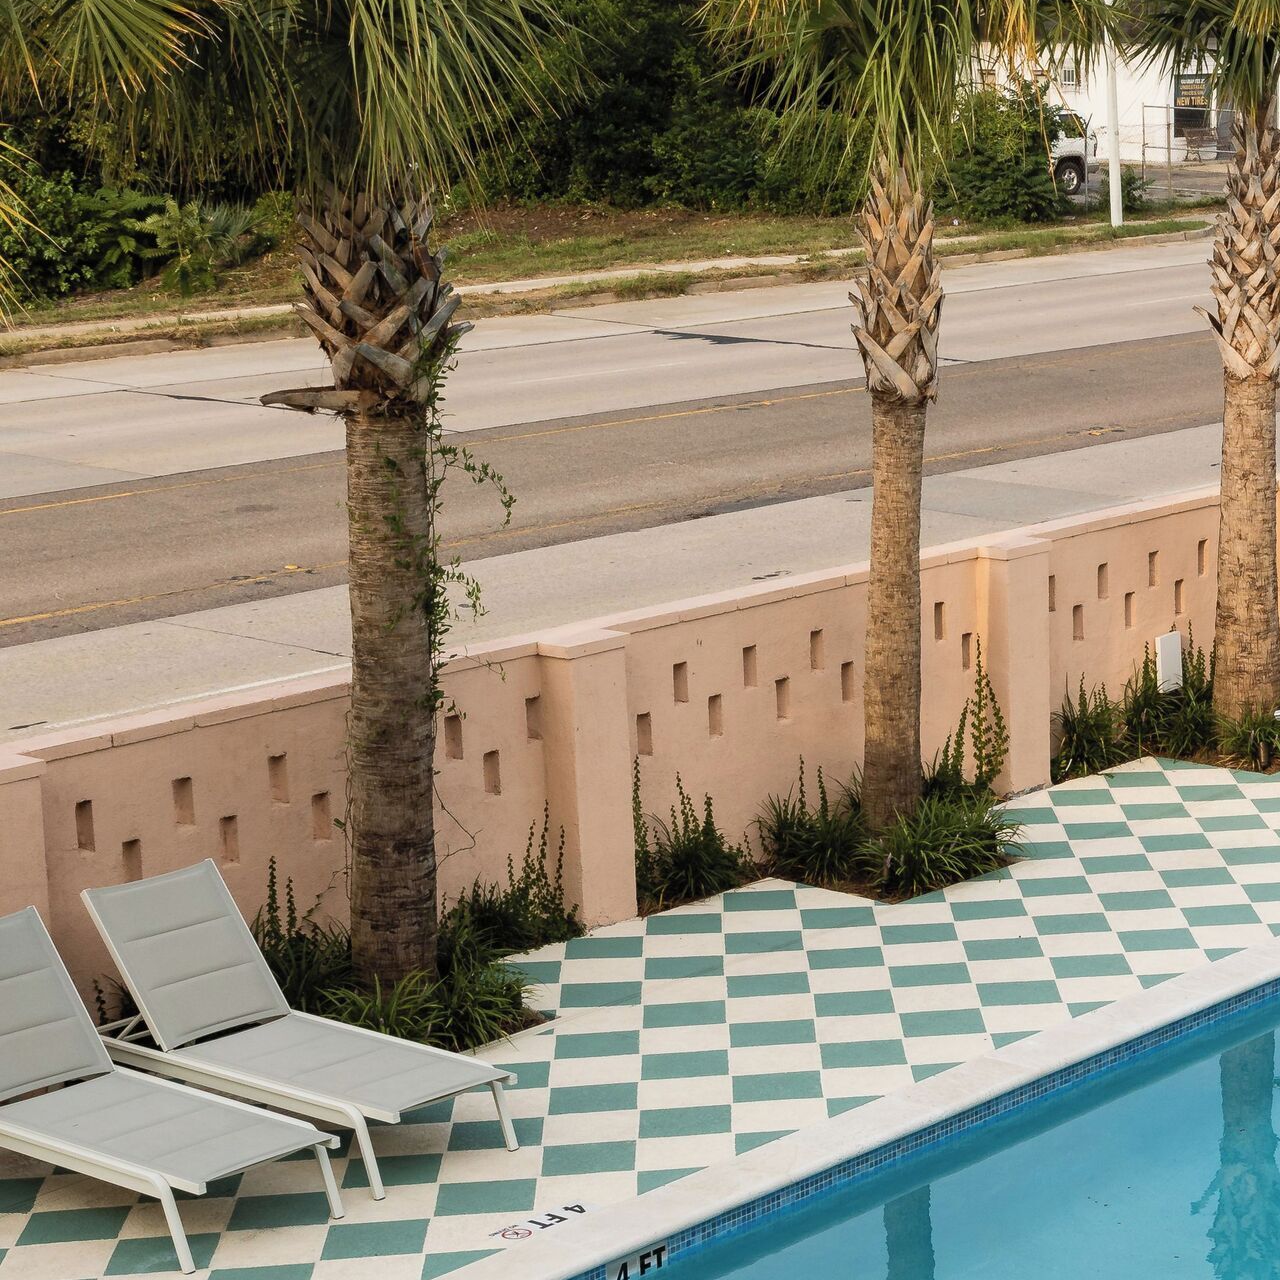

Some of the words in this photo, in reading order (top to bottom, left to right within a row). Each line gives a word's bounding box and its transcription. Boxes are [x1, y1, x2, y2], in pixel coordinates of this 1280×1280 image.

[1176, 96, 1190, 106] NEW
[563, 1204, 586, 1214] 4
[528, 1213, 568, 1229] FT
[639, 1246, 666, 1276] FT
